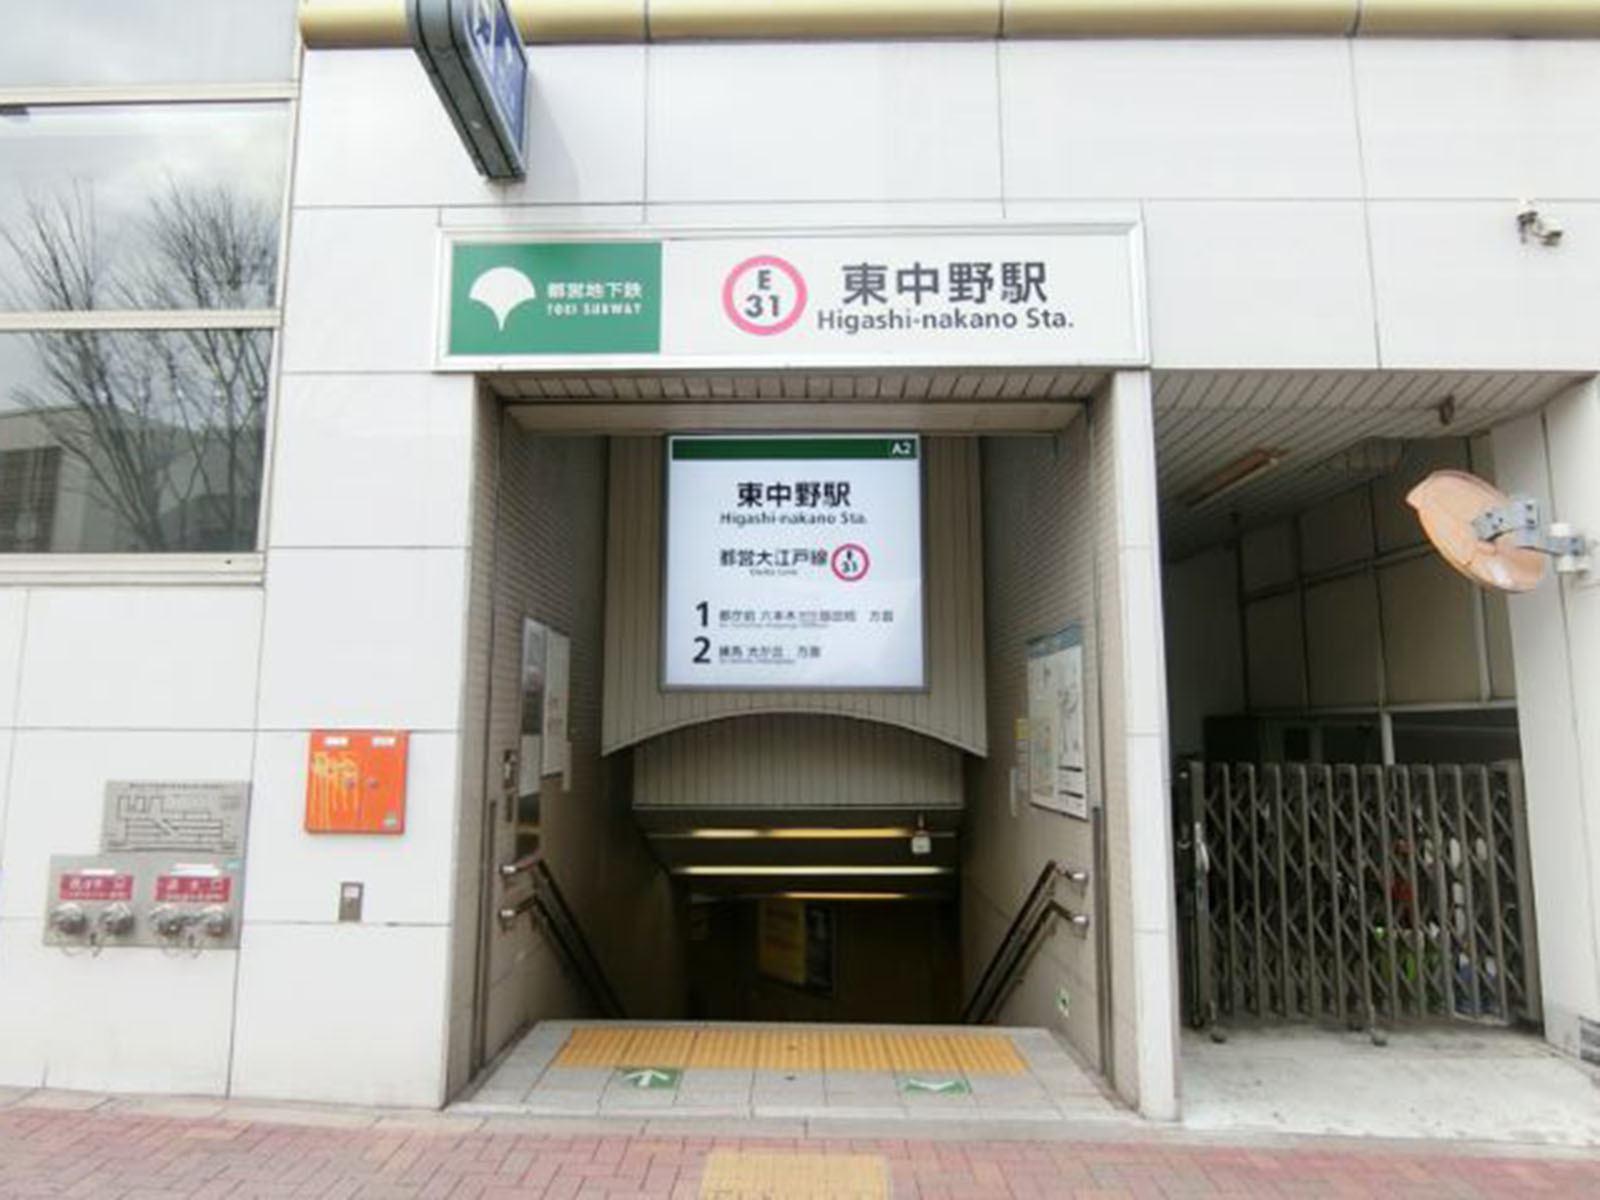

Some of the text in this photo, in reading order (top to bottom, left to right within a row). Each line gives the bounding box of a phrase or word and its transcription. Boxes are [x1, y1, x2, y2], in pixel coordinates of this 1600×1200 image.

[547, 281, 643, 299] 都営地下鉄
[757, 269, 772, 291] E
[842, 261, 1048, 306] 東中野駅
[743, 295, 780, 318] 31
[816, 307, 1074, 334] Higashi-nakano Sta.
[891, 442, 912, 456] A2
[737, 481, 851, 508] 東中野駅
[720, 511, 868, 528] Higashi-nakano Sta.
[720, 548, 829, 567] 都営大江戸線
[695, 601, 709, 628] 1
[692, 635, 712, 665] 2
